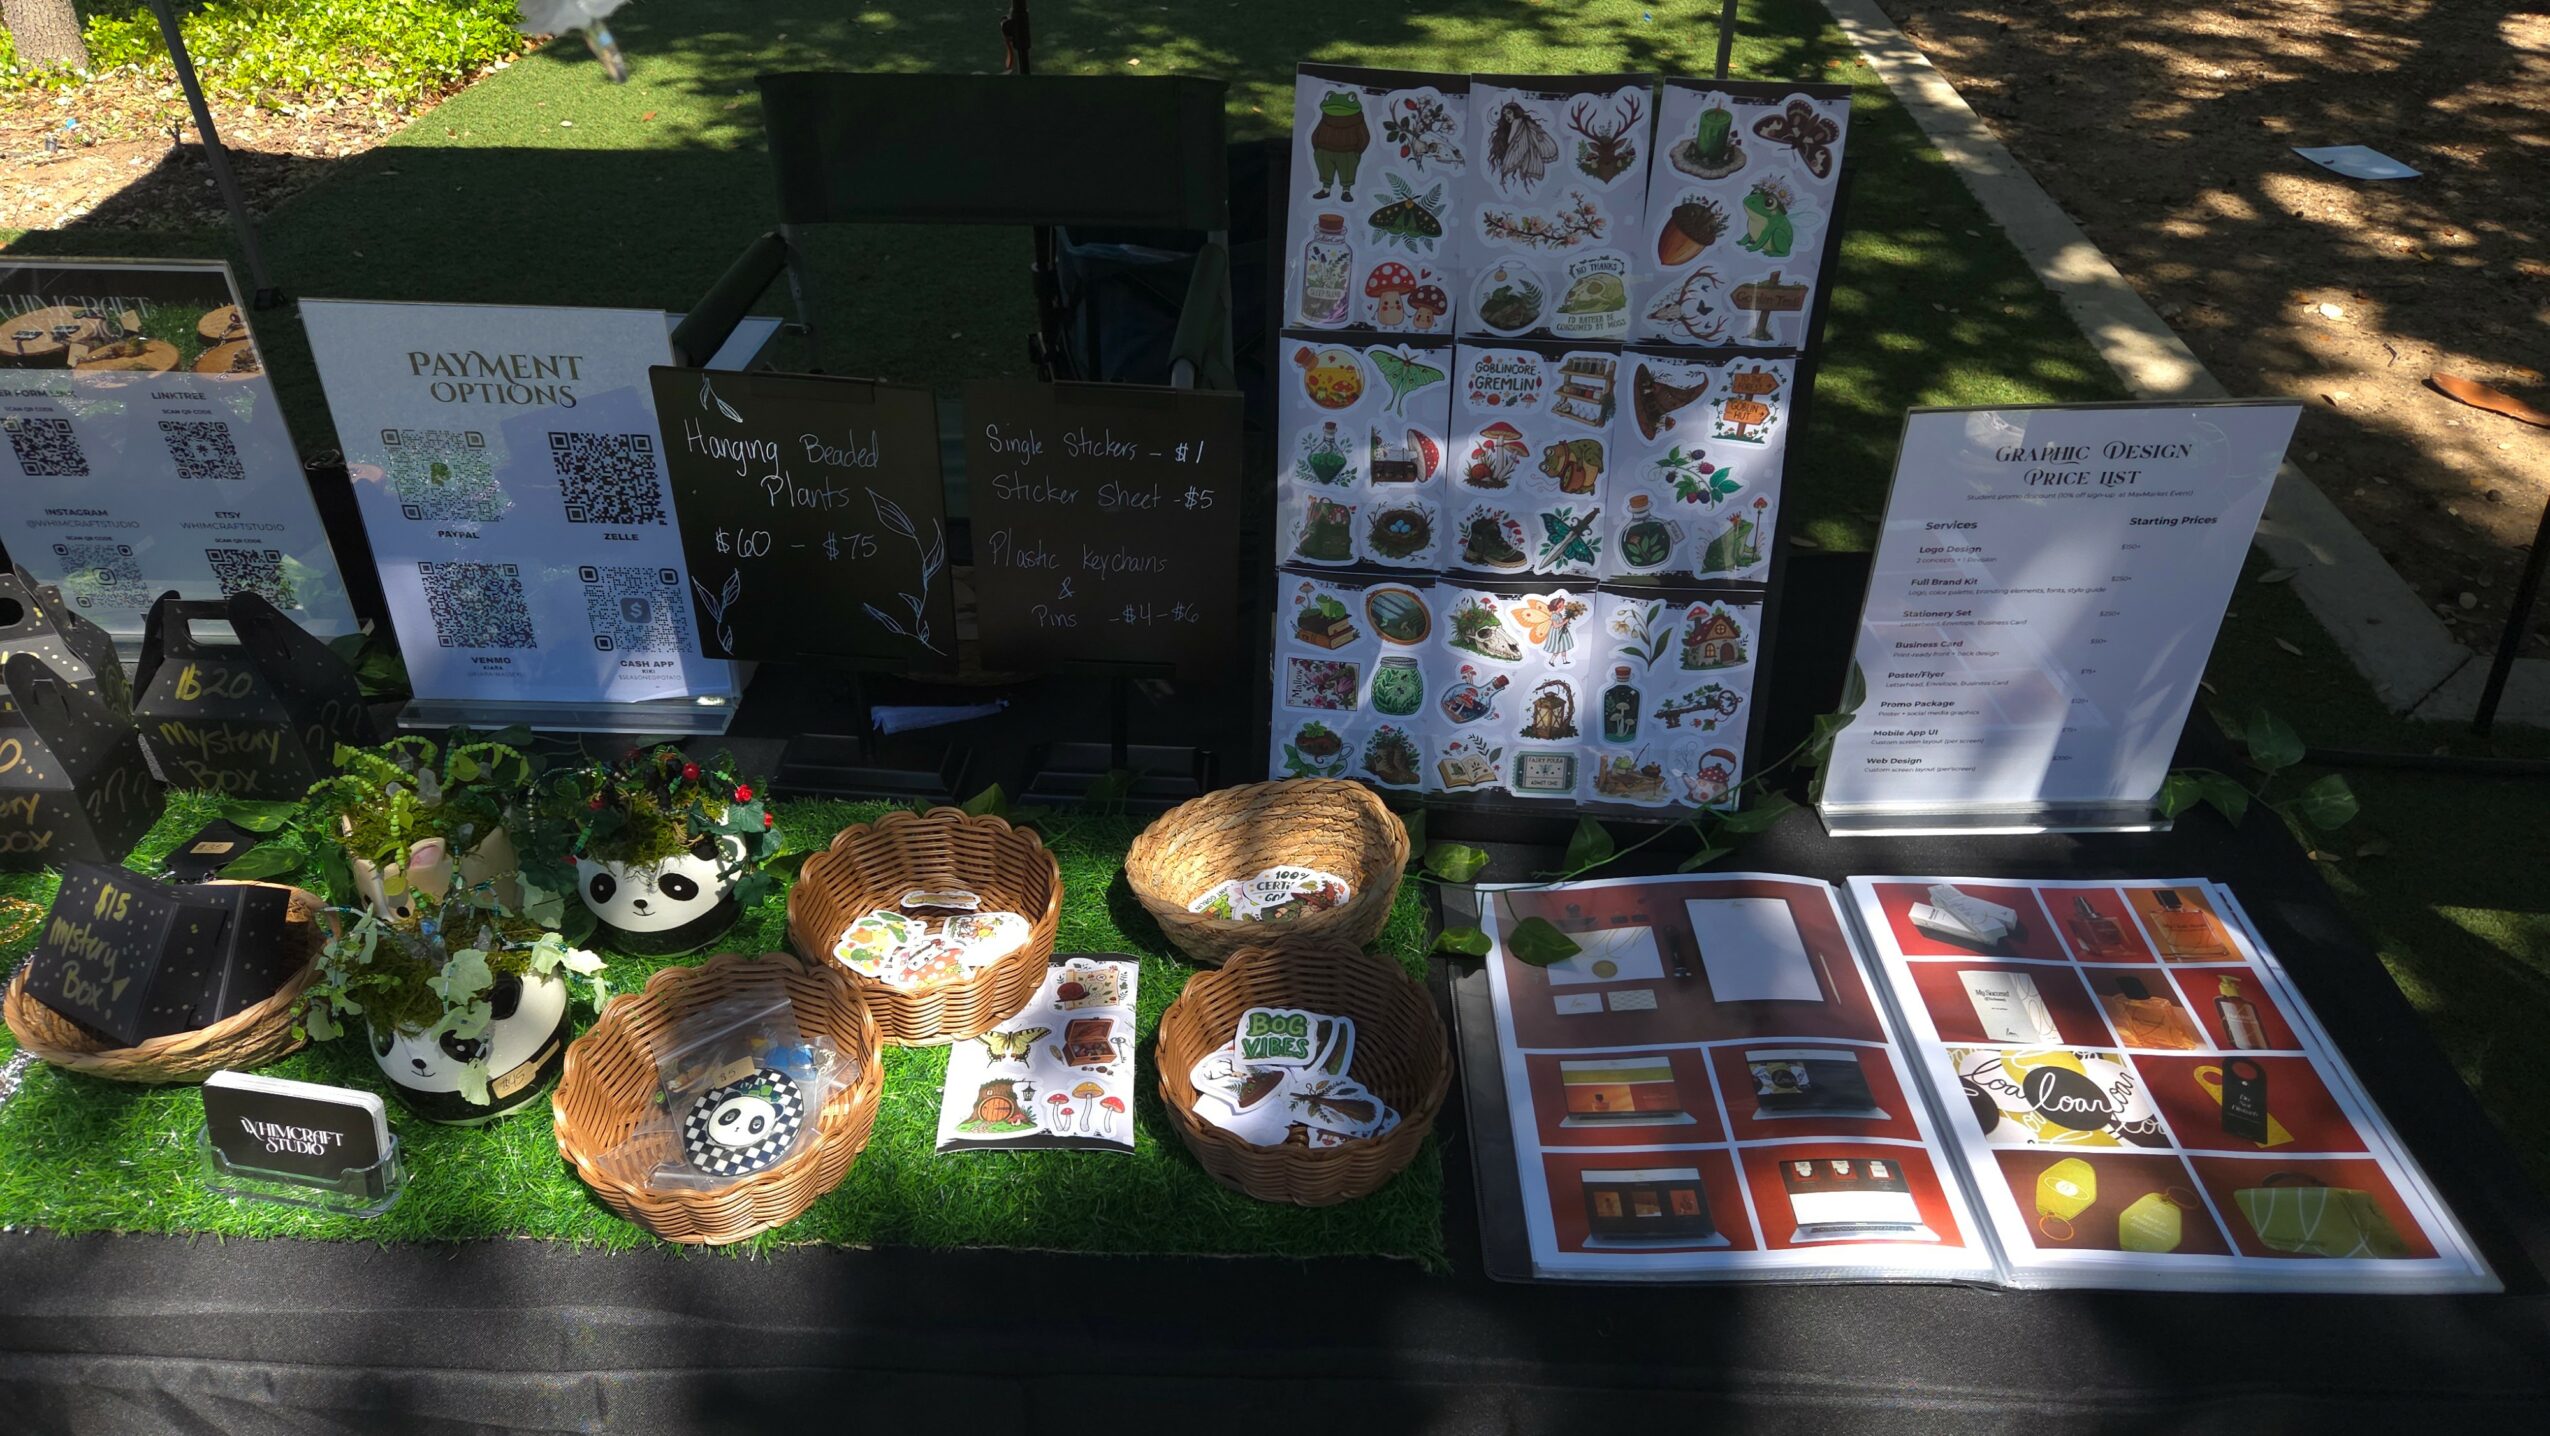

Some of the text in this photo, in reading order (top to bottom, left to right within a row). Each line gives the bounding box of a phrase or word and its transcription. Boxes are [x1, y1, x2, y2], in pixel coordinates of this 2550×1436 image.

[1590, 262, 1618, 271] THANKS
[406, 350, 583, 381] PAYMENT
[13, 390, 48, 398] FORM
[151, 391, 207, 400] LINKTREE
[430, 381, 577, 409] OPTIONS
[1733, 411, 1751, 420] HUT
[684, 418, 880, 477] Hanging Beaded
[985, 422, 1205, 467] Single Stickers $1
[1994, 440, 2193, 466] GRAPHIC DESIGN
[2023, 467, 2142, 488] PRICE LIST
[760, 475, 850, 511] Plants
[993, 473, 1079, 508] Sticker
[1097, 473, 1161, 511] Sheet
[1966, 493, 1997, 501] Student
[45, 508, 109, 517] INSTAGRAM
[214, 511, 240, 519] ETSY
[1925, 520, 1978, 531] Services
[2129, 515, 2218, 528] Starting Prices
[179, 522, 285, 532] WHIMCRAFTSTUDIO
[437, 530, 480, 539] PAYPAL
[603, 532, 640, 541] ZELLE
[716, 526, 878, 561] $60 $75
[988, 529, 1060, 569] Plastic
[1919, 545, 1982, 555] Logo Design
[1922, 557, 1955, 565] concepts
[1911, 577, 1979, 586] Full Brand Kit
[1057, 576, 1076, 600] &
[1031, 603, 1078, 629] Pins
[1903, 609, 1973, 619] Stationery Set
[1895, 640, 1939, 649] Business
[1975, 650, 2000, 658] design
[471, 656, 512, 665] VENMO
[620, 660, 675, 669] CASH APP
[1888, 670, 1945, 680] Poster/Flyer
[175, 661, 256, 701] $20
[1292, 667, 1303, 698] Mallow
[1914, 699, 1956, 708] Package
[1950, 709, 1980, 717] graphics
[1873, 728, 1939, 737] Mobile App UI
[158, 720, 281, 765] Mystery
[1866, 757, 1923, 766] Web Design
[1275, 870, 1310, 880] 100%
[93, 880, 133, 922] $15
[1246, 1012, 1307, 1037] BOG
[1241, 1037, 1309, 1059] VIBES
[240, 1115, 344, 1148] WHIMCRAFT
[265, 1136, 326, 1157] STUDIO
